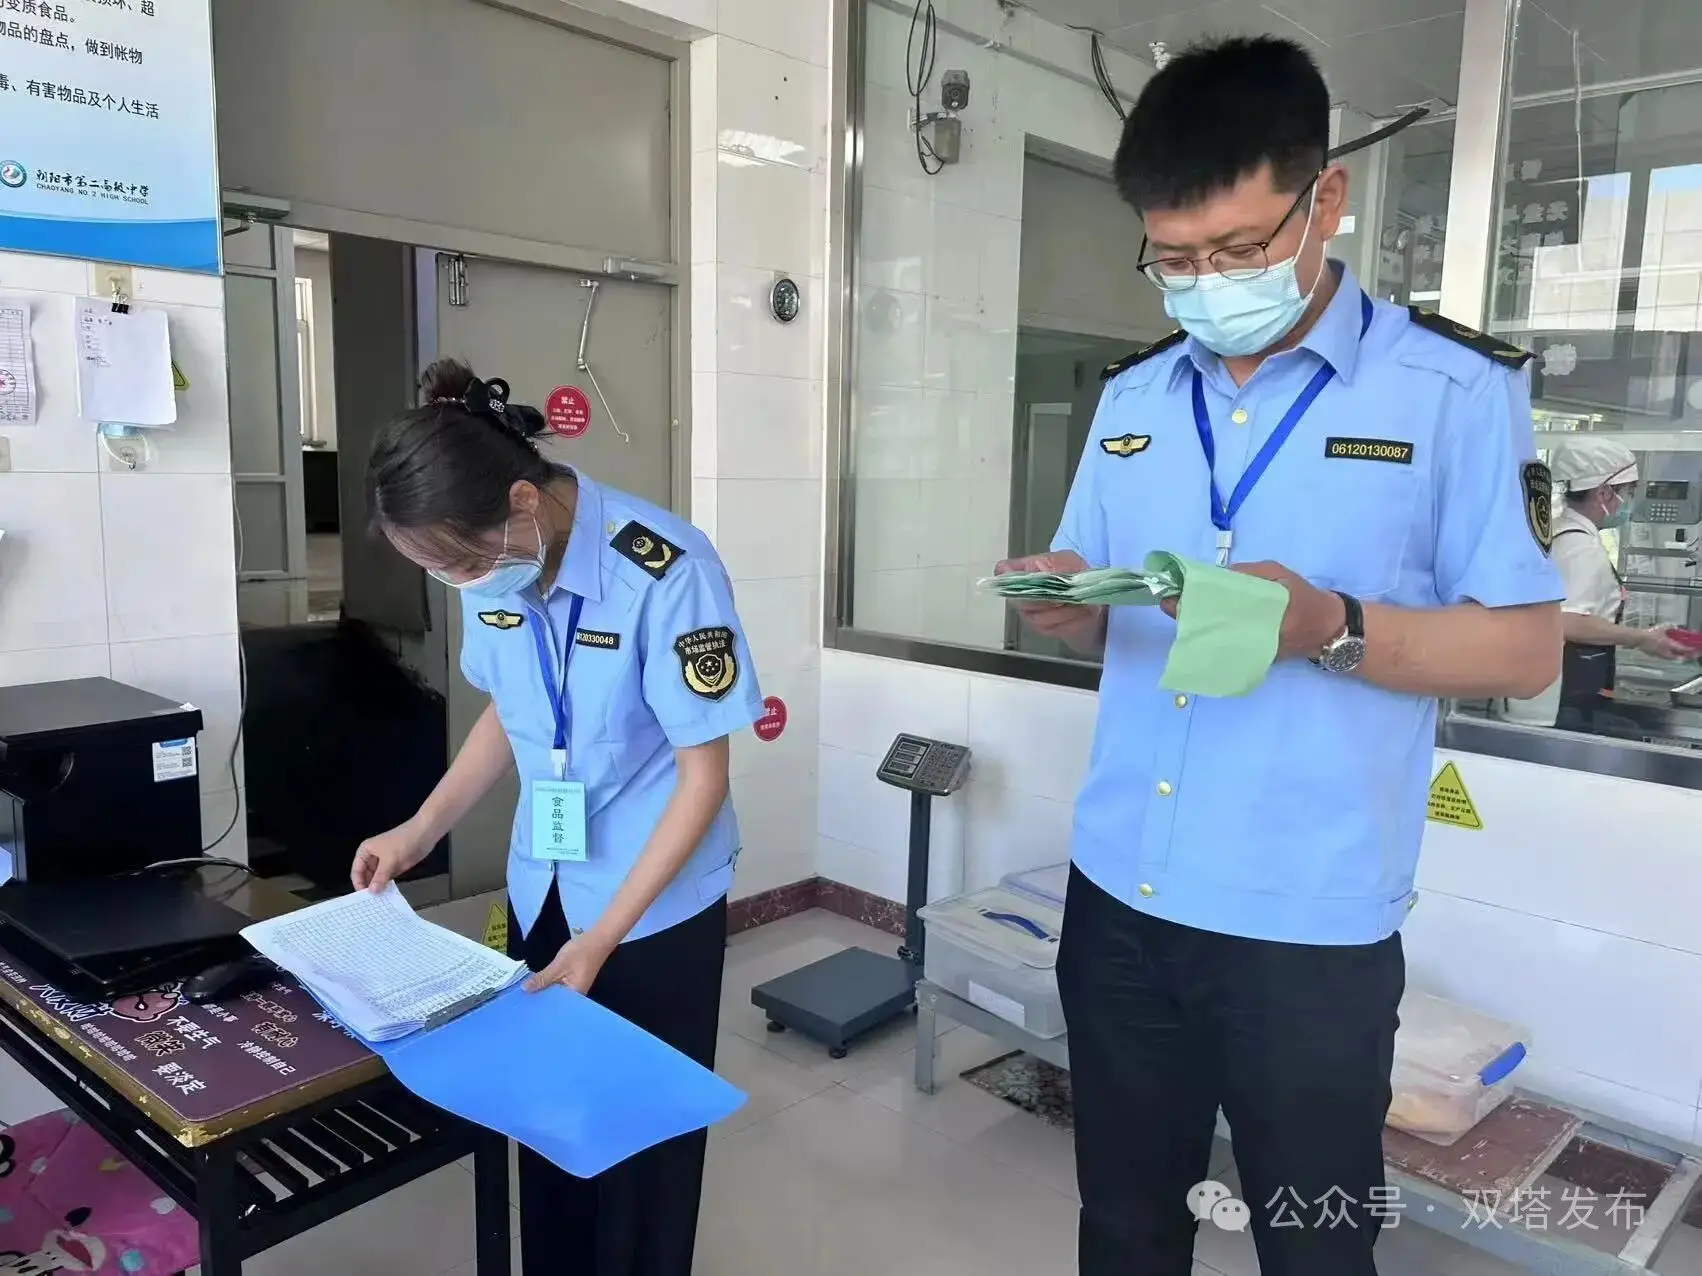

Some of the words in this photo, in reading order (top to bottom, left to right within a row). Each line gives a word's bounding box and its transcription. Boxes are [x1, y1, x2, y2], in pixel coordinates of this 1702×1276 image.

[0, 0, 76, 23] 变质食品。
[36, 183, 74, 194] CHAOYANG
[100, 192, 119, 200] HIGH
[122, 195, 149, 205] SCHOOL
[1331, 443, 1408, 458] 06120130087
[551, 796, 564, 843] 食品监督
[134, 1030, 186, 1057] 微笑
[166, 1015, 222, 1050] 不要生气
[250, 1021, 299, 1048] 有耐心
[236, 1040, 297, 1076] 冷静控制自己
[151, 1061, 207, 1096] 要淡定
